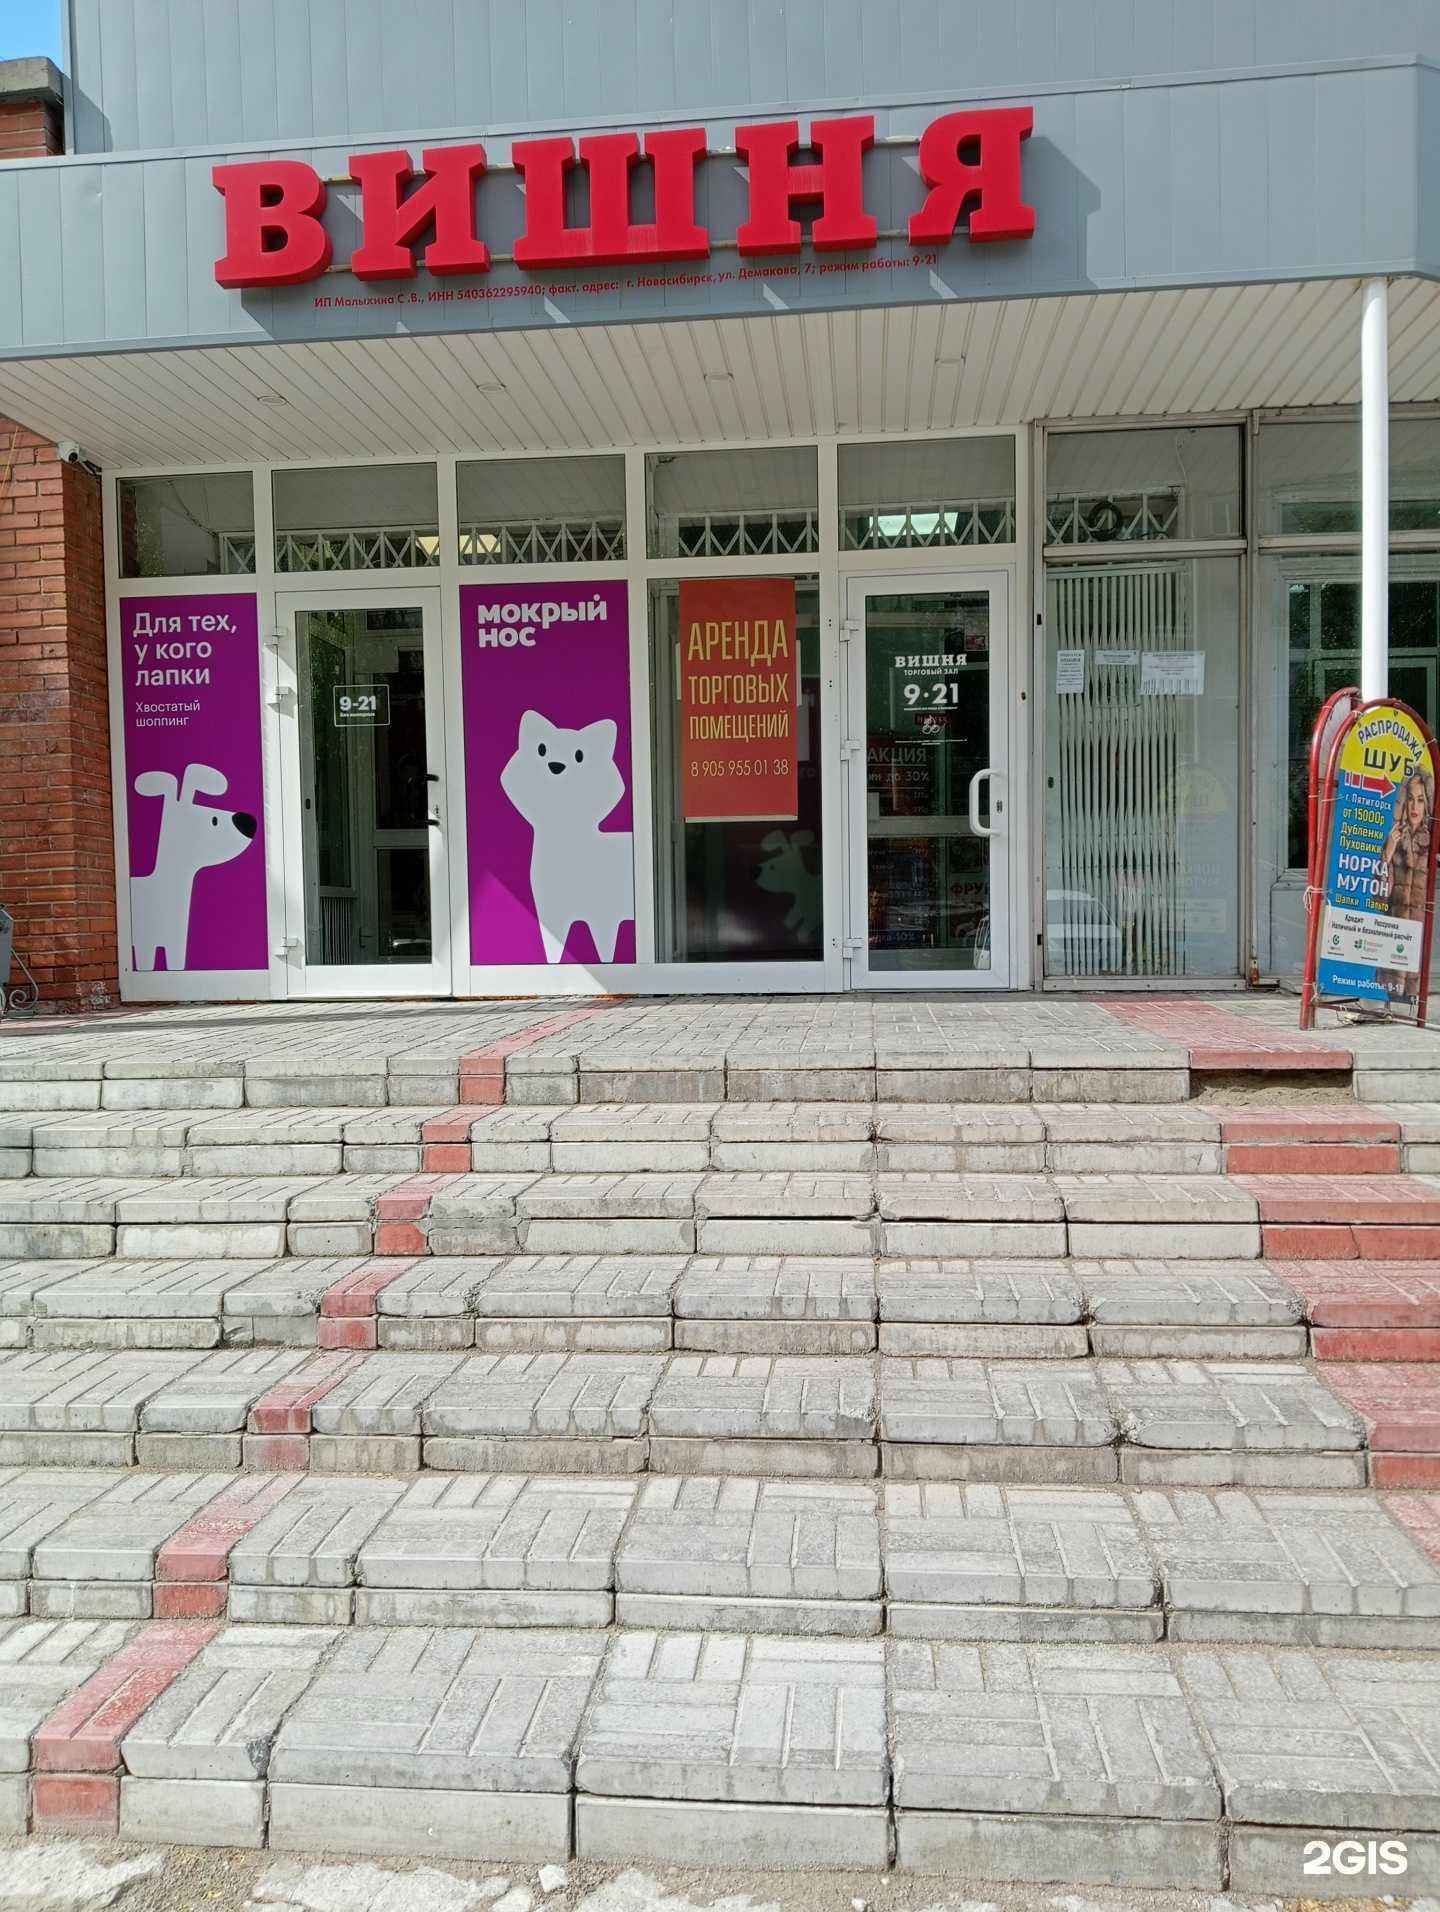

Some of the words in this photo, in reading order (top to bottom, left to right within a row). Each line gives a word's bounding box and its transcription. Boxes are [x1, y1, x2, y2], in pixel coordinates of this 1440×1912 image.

[212, 106, 1035, 289] ВИШНЯ
[314, 297, 332, 308] ИП
[428, 290, 454, 302] ИНН
[582, 281, 619, 296] адрес:
[626, 280, 635, 288] г.
[637, 271, 717, 288] Новосибирск,
[719, 271, 735, 283] ул.
[738, 265, 800, 281] Демакова,
[804, 262, 816, 275] 7;
[819, 262, 859, 276] режим
[862, 257, 910, 273] работы:
[477, 593, 608, 629] мокрый
[132, 612, 181, 637] Для
[188, 612, 238, 635] тех,
[478, 626, 537, 648] нос
[687, 619, 789, 667] АРЕНДА
[134, 642, 149, 665] у
[155, 641, 213, 660] кого
[894, 653, 968, 668] ВИШНЯ
[135, 666, 211, 687] лапки
[904, 667, 943, 676] ТОРГОВЫЙ
[944, 667, 959, 675] ЗАЛ
[688, 673, 789, 705] ТОРГОВЫХ
[135, 699, 201, 713] Хвостатый
[339, 695, 377, 711] 9-21
[135, 716, 190, 728] шоппинг
[689, 710, 789, 743] ПОМЕЩЕНИЙ
[1357, 719, 1423, 762] РАСПРОДАЖА
[868, 747, 926, 764] АКЦИЯ
[1363, 747, 1415, 777] ШУБ
[690, 762, 700, 777] 8
[702, 760, 725, 777] 905
[728, 760, 751, 776] 955
[754, 760, 769, 775] 01
[773, 759, 790, 775] 38
[1351, 793, 1392, 811] Пятигорск
[1343, 808, 1353, 818] от
[1354, 807, 1385, 826] 15000р
[1338, 853, 1389, 878] НОРКА
[1336, 873, 1389, 898] МУТОН
[1332, 974, 1356, 986] Режим
